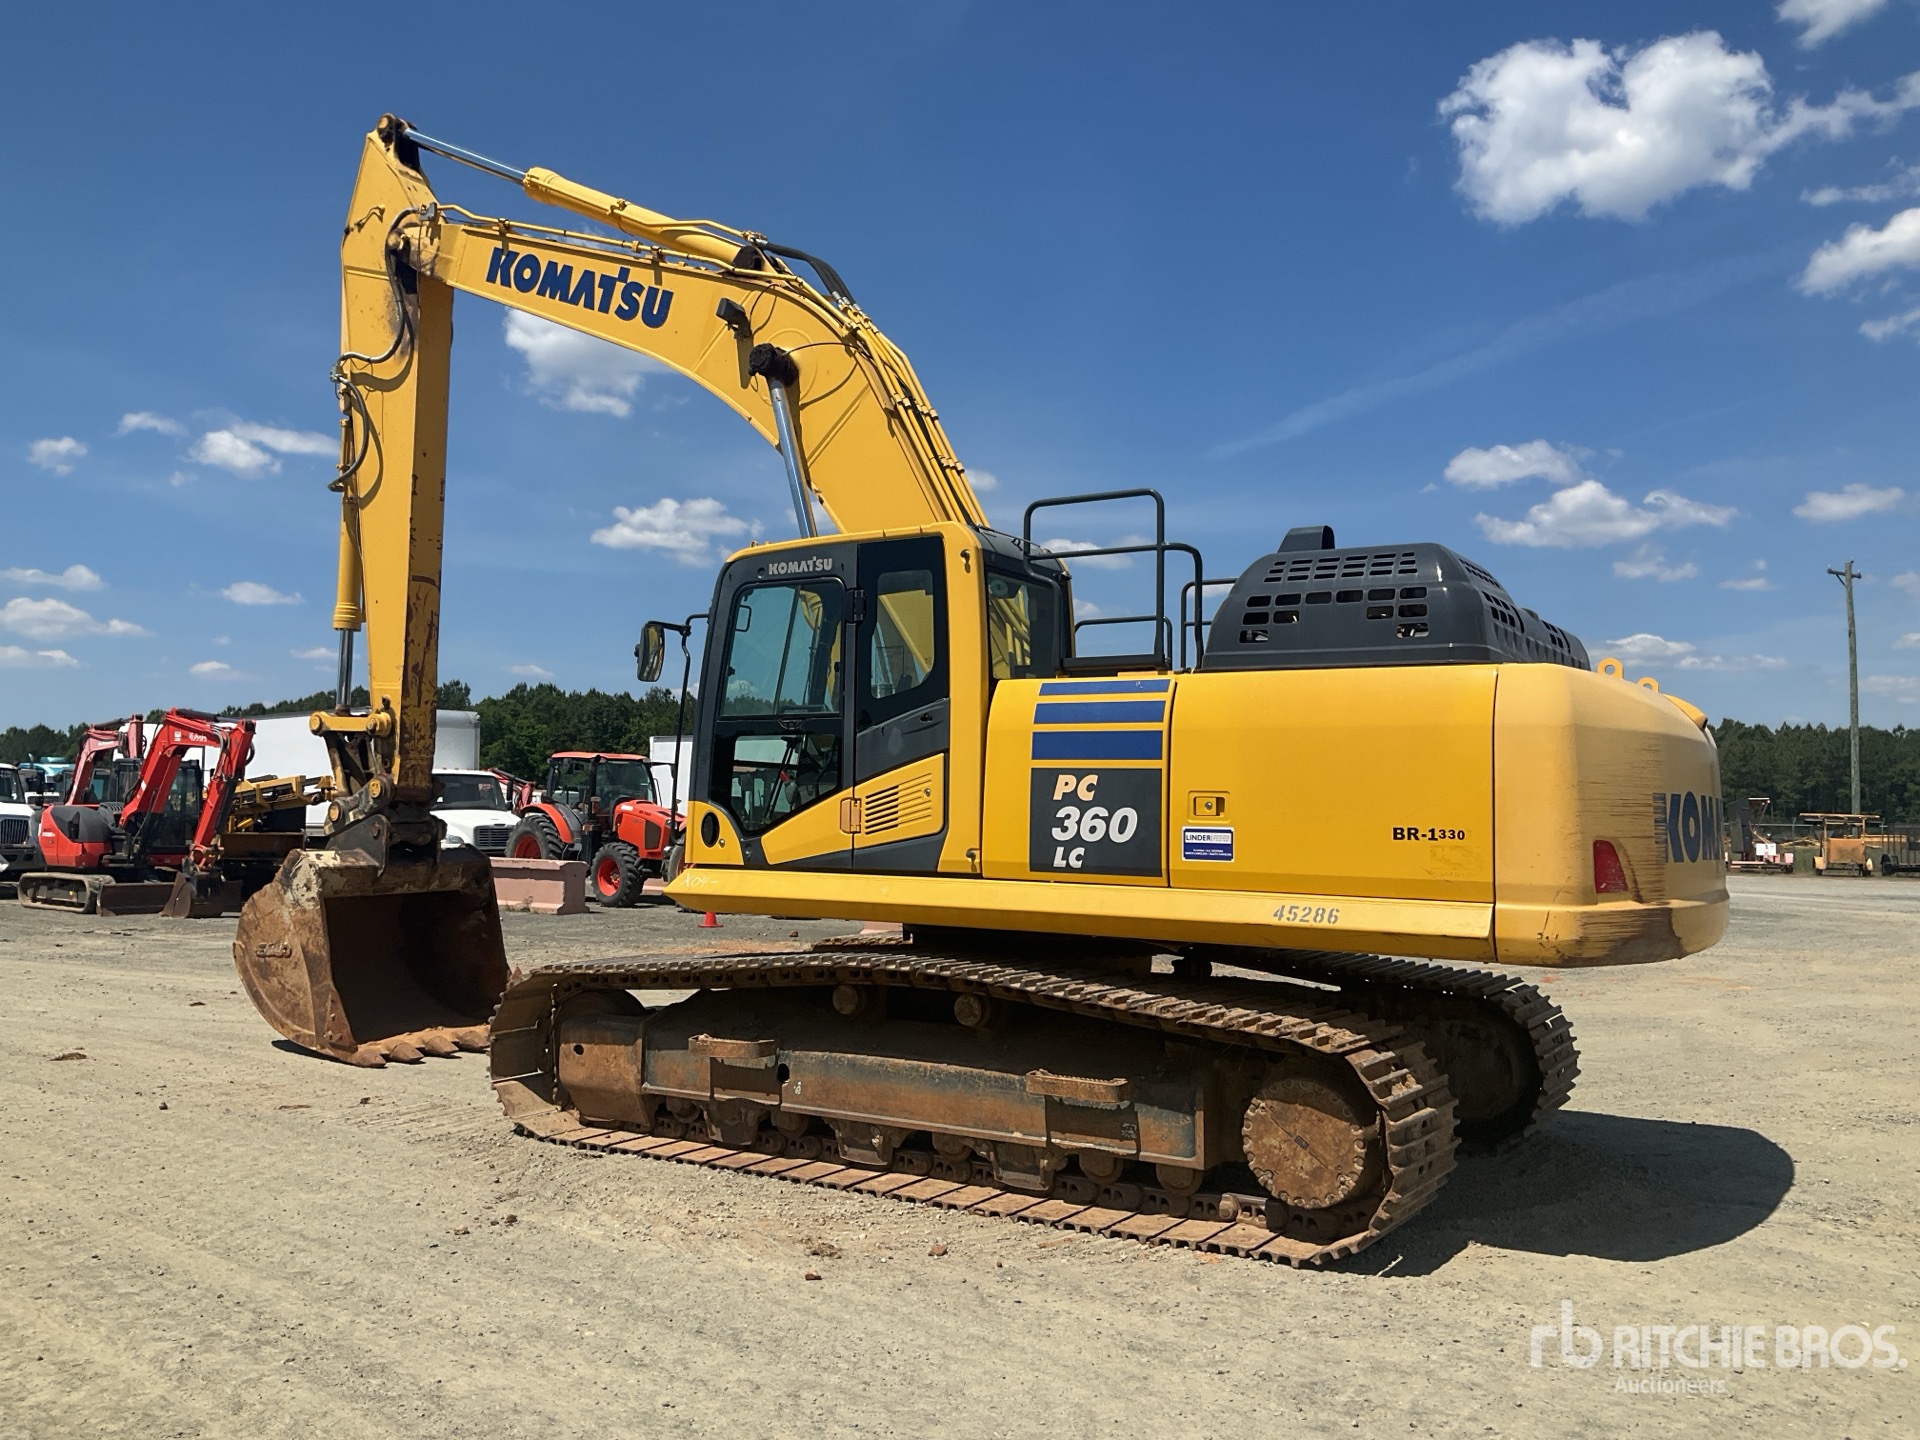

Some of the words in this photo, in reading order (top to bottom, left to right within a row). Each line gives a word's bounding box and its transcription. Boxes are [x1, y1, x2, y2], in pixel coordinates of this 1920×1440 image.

[486, 247, 674, 328] KOMATSU
[768, 556, 833, 575] KOMATSU
[1053, 774, 1099, 801] PC
[1051, 806, 1138, 843] 360
[1392, 827, 1466, 841] BR-1330
[1186, 834, 1211, 842] LINDER
[1053, 847, 1085, 869] LC
[1273, 905, 1340, 924] 45286
